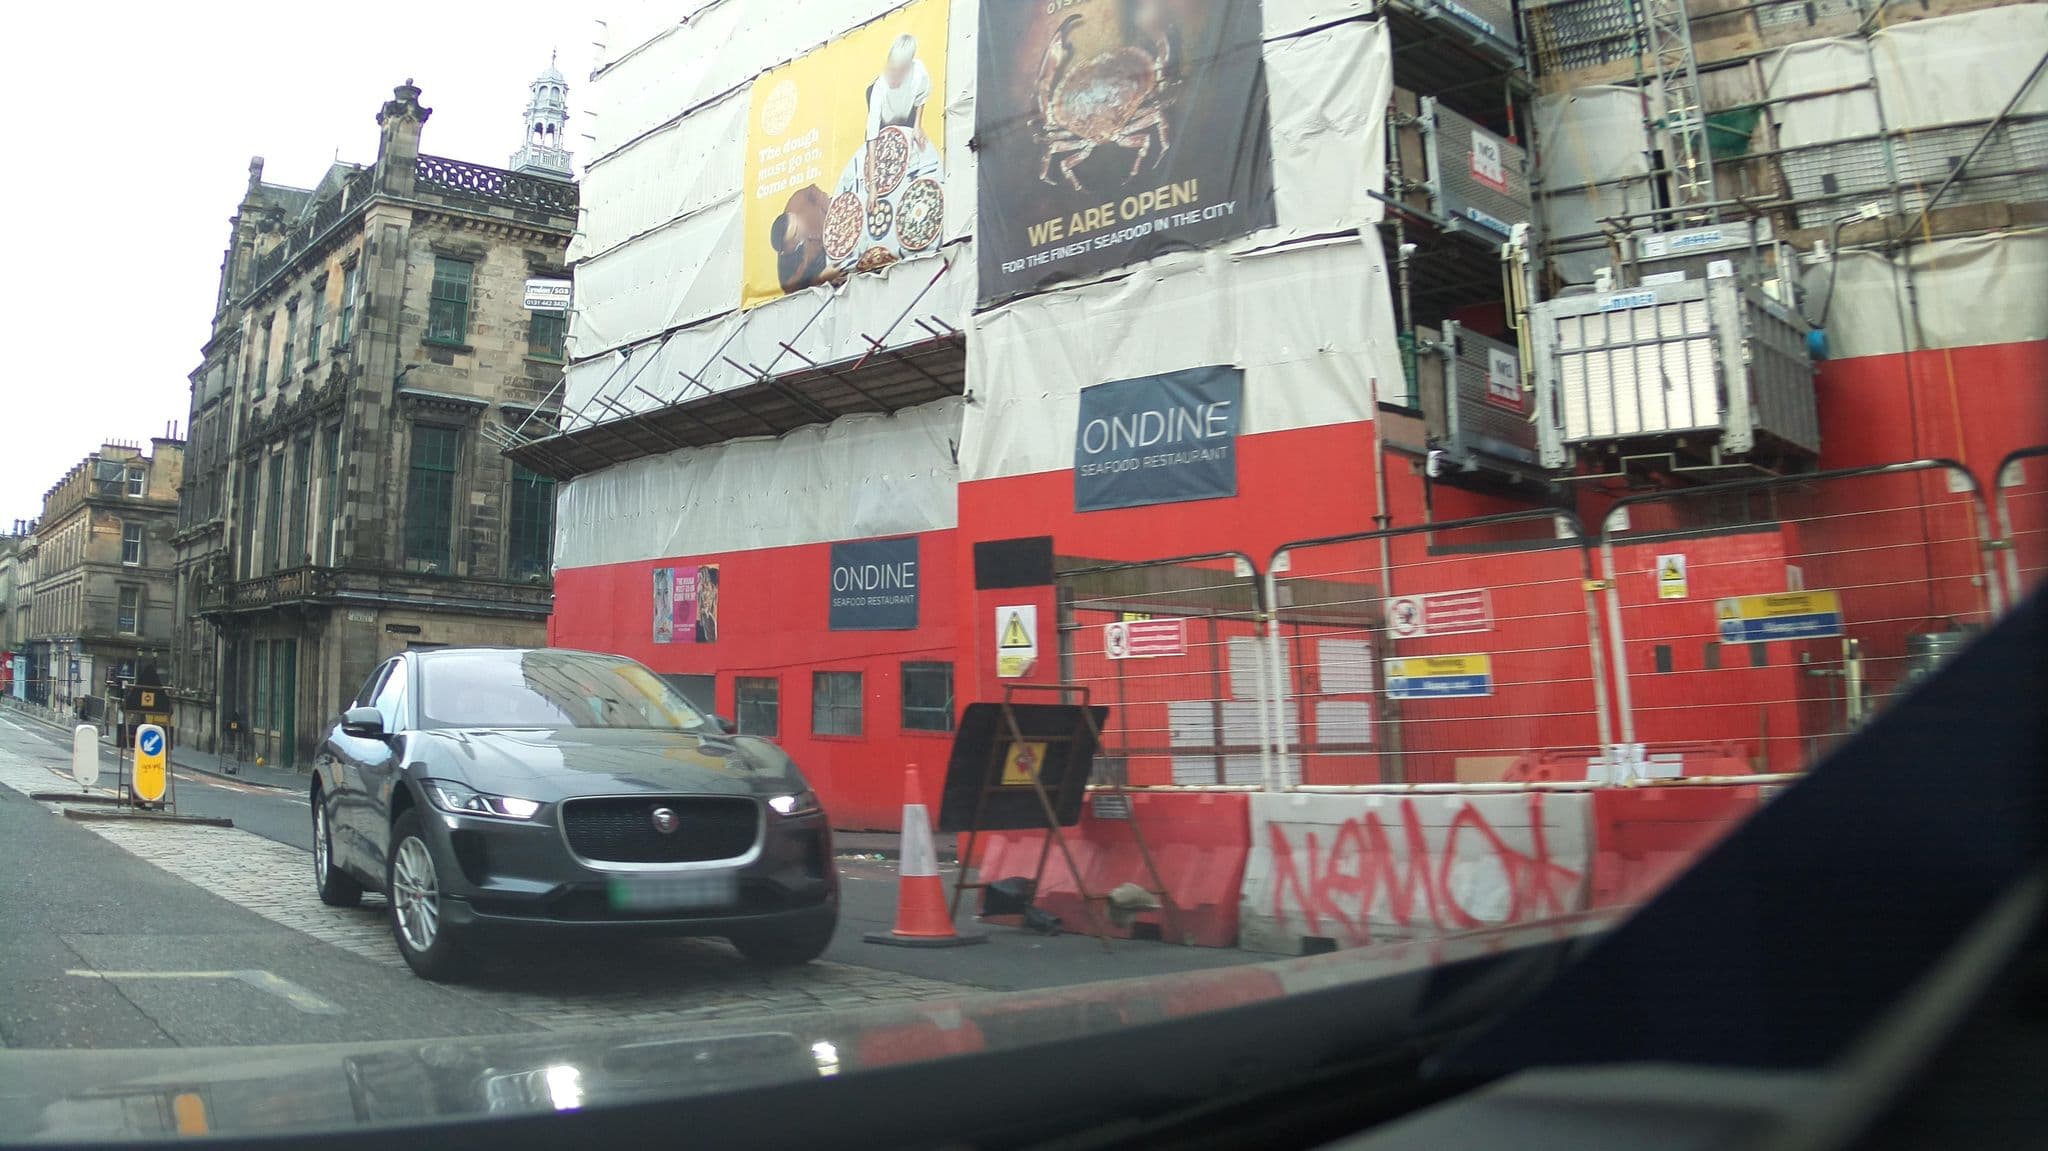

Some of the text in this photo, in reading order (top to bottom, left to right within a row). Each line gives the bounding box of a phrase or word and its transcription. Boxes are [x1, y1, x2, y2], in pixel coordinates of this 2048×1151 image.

[759, 128, 819, 163] The dough
[758, 161, 787, 180] must
[788, 155, 802, 174] go
[757, 179, 788, 199] Come
[789, 173, 804, 187] on
[1027, 178, 1199, 248] WE ARE OPEN!
[1001, 200, 1237, 274] FOR THE FINEST SEAFOOD IN THE CITY
[1083, 400, 1231, 454] ONDINE
[1080, 446, 1228, 477] SEAFOOD RESTAURANT
[833, 562, 915, 592] ONDINE
[832, 594, 915, 607] SEAFOOD RESTAURANT
